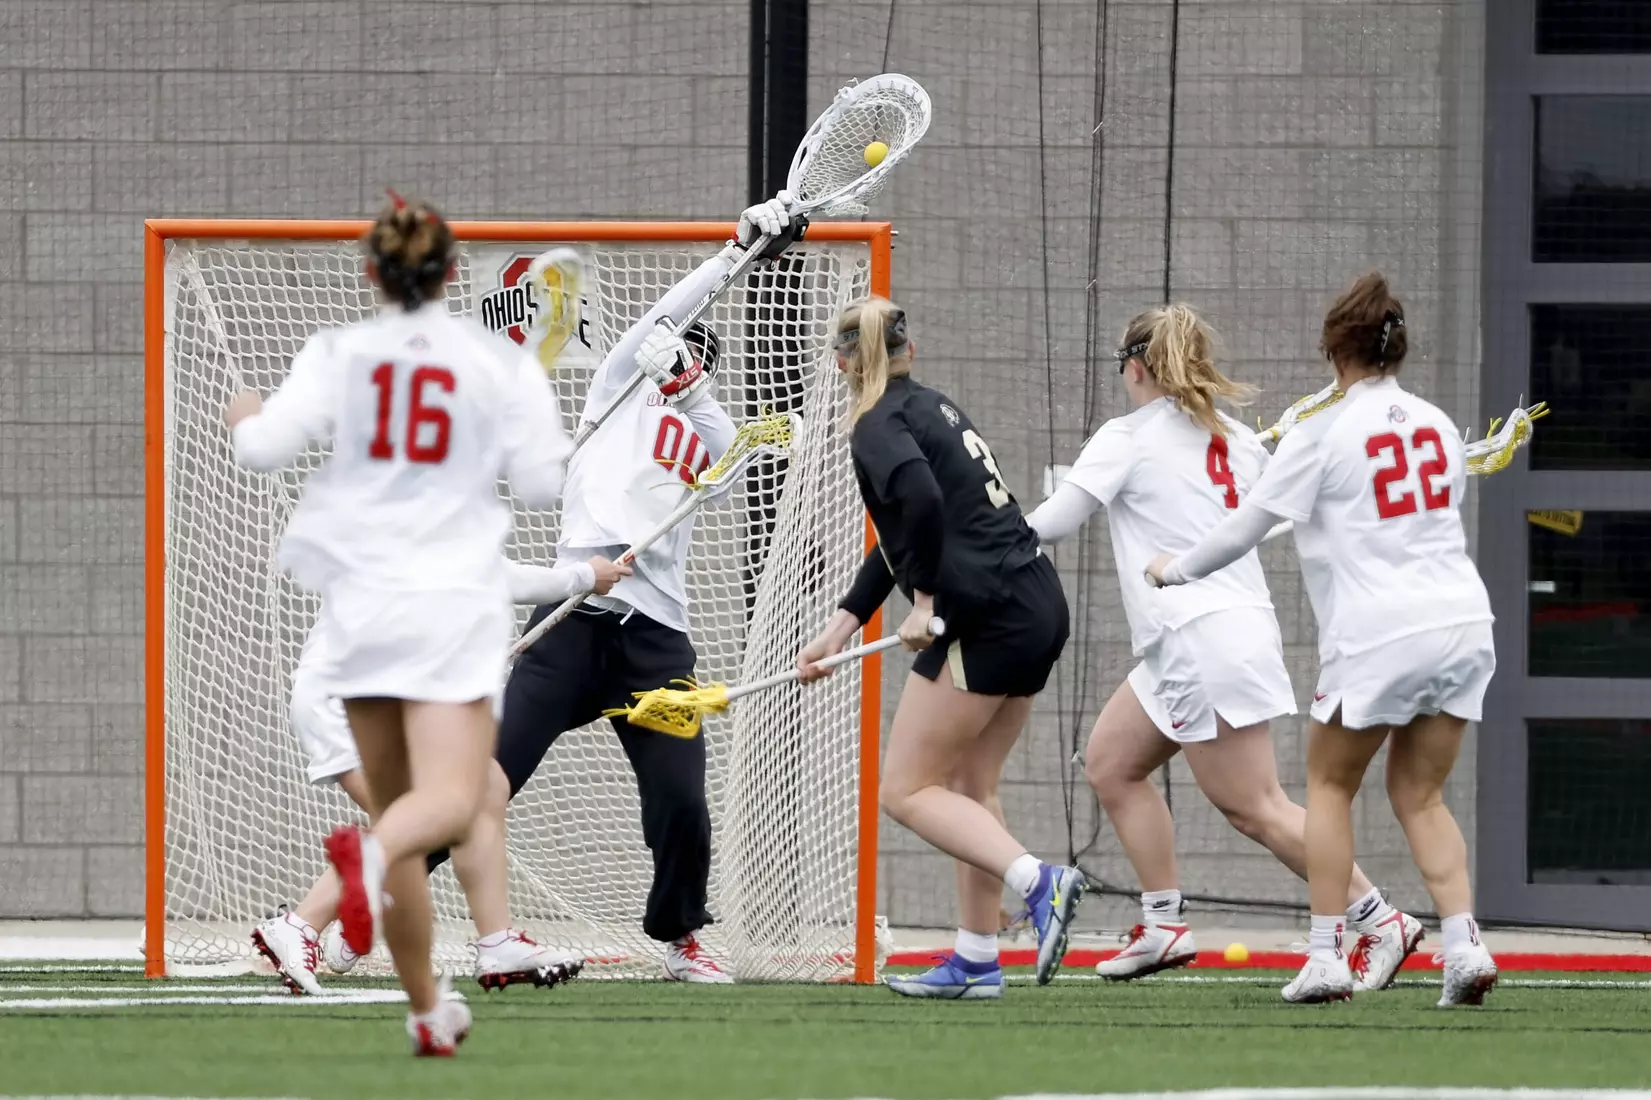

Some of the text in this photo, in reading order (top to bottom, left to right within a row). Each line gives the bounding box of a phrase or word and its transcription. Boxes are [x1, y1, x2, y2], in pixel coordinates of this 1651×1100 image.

[482, 288, 525, 334] OHIO
[369, 361, 457, 465] 16
[675, 366, 699, 390] STX
[652, 414, 711, 487] 00
[961, 428, 1011, 510] 3
[1206, 432, 1239, 510] 4
[1364, 426, 1451, 520] 22
